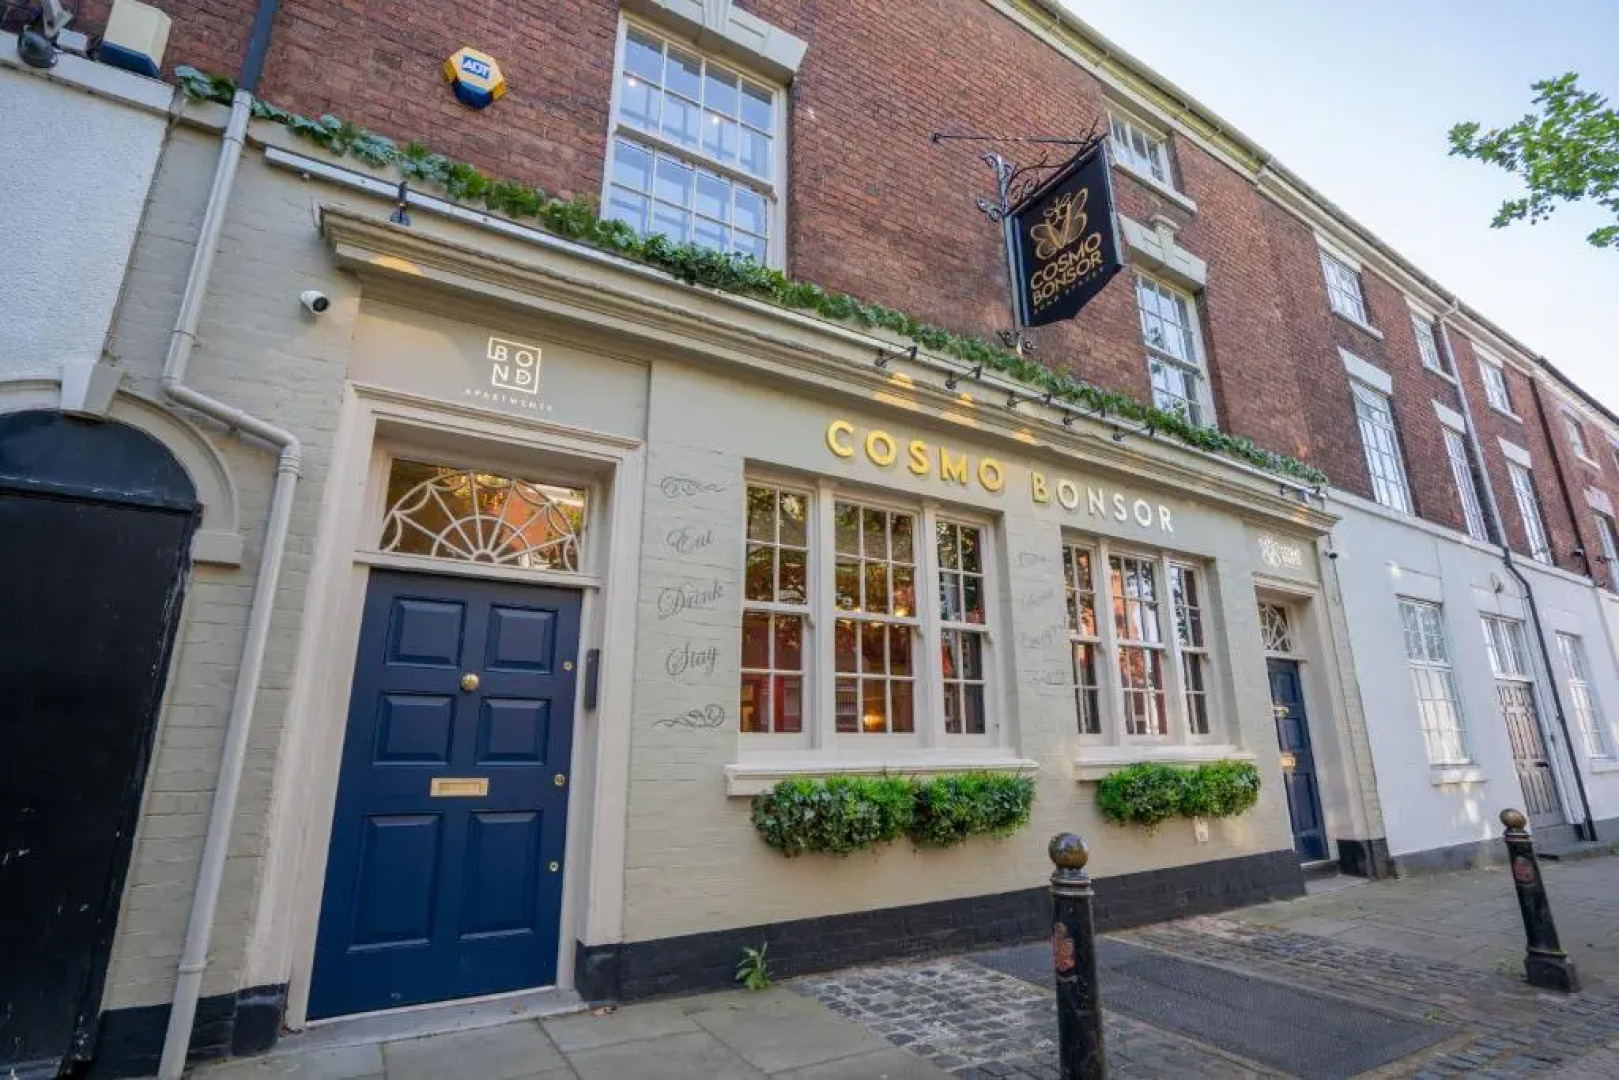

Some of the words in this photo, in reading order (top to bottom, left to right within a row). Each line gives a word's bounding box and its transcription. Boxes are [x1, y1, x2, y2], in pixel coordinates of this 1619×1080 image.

[462, 59, 490, 78] ADT
[1031, 231, 1101, 289] COSMO
[1033, 251, 1103, 307] BONSOR
[825, 420, 1006, 492] COSMO
[1031, 470, 1175, 533] BONSOR
[657, 577, 722, 620] Drink
[666, 641, 721, 681] Stay
